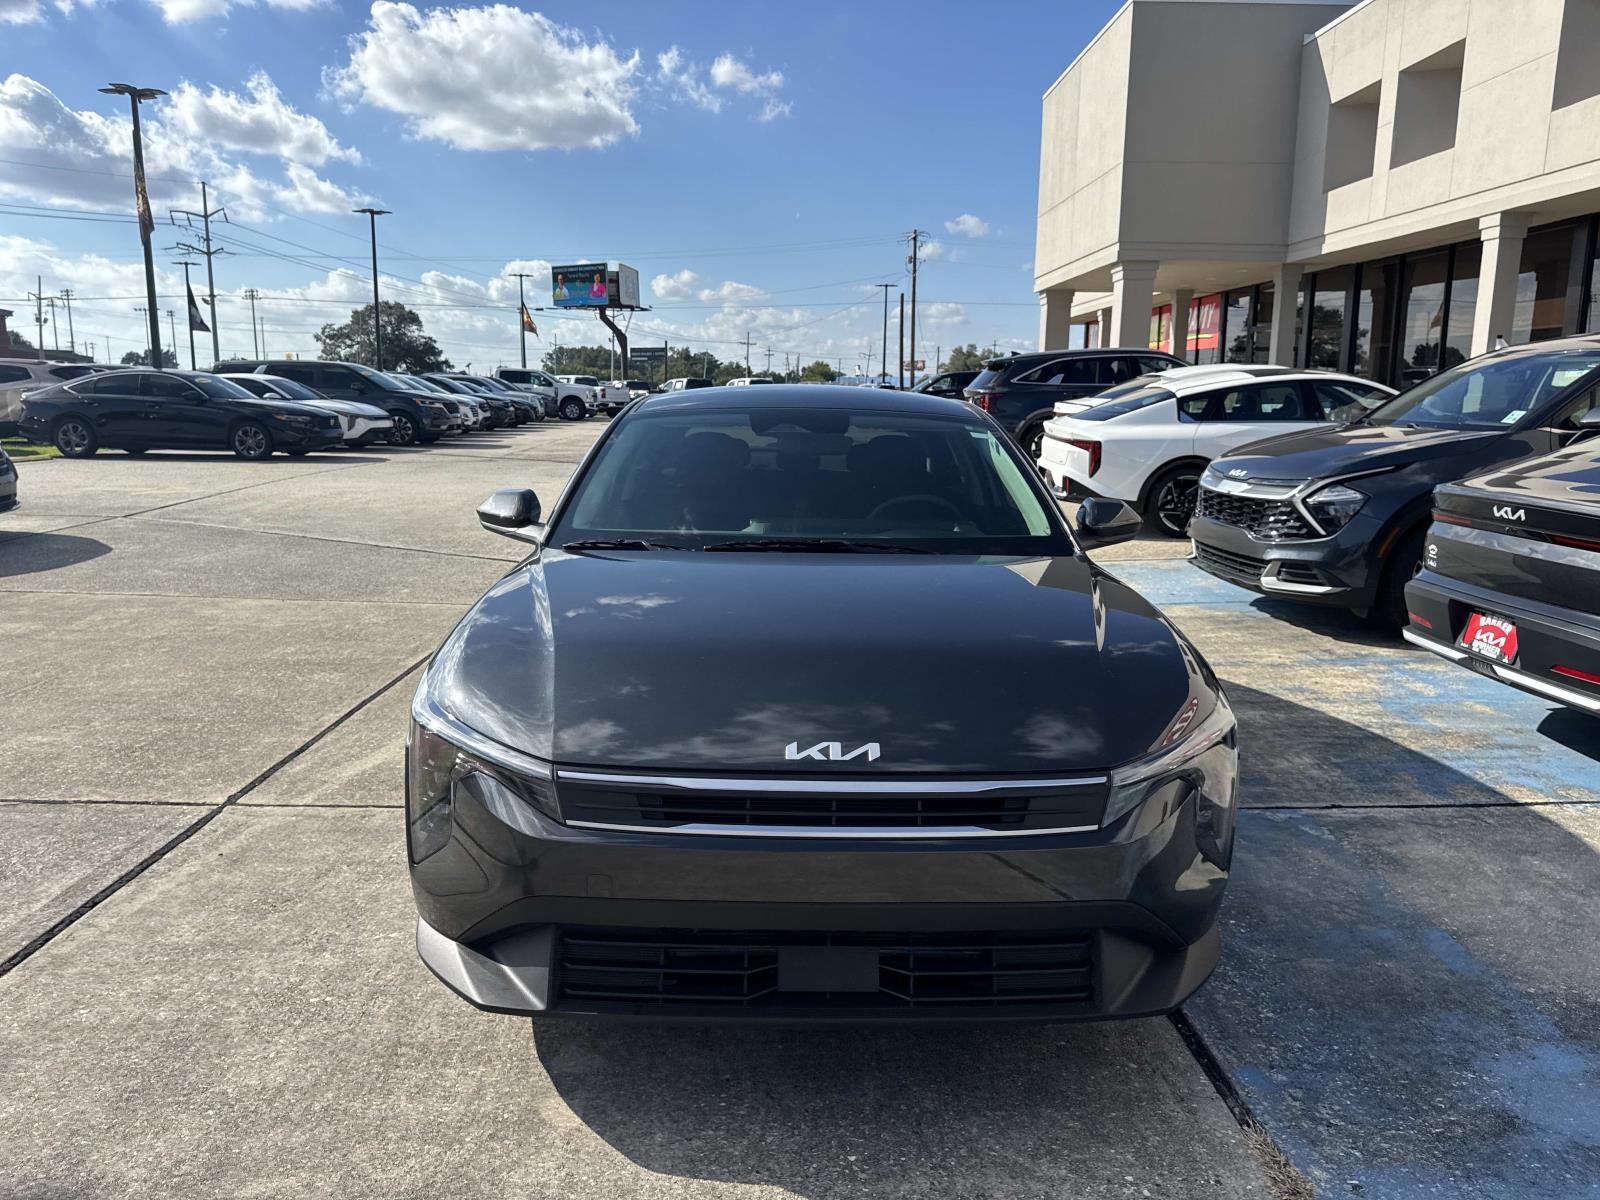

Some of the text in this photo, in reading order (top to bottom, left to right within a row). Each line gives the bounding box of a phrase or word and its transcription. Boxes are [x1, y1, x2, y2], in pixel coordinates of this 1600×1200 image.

[1493, 505, 1526, 521] KIA
[1475, 629, 1507, 648] KIA
[785, 741, 881, 762] KIA
